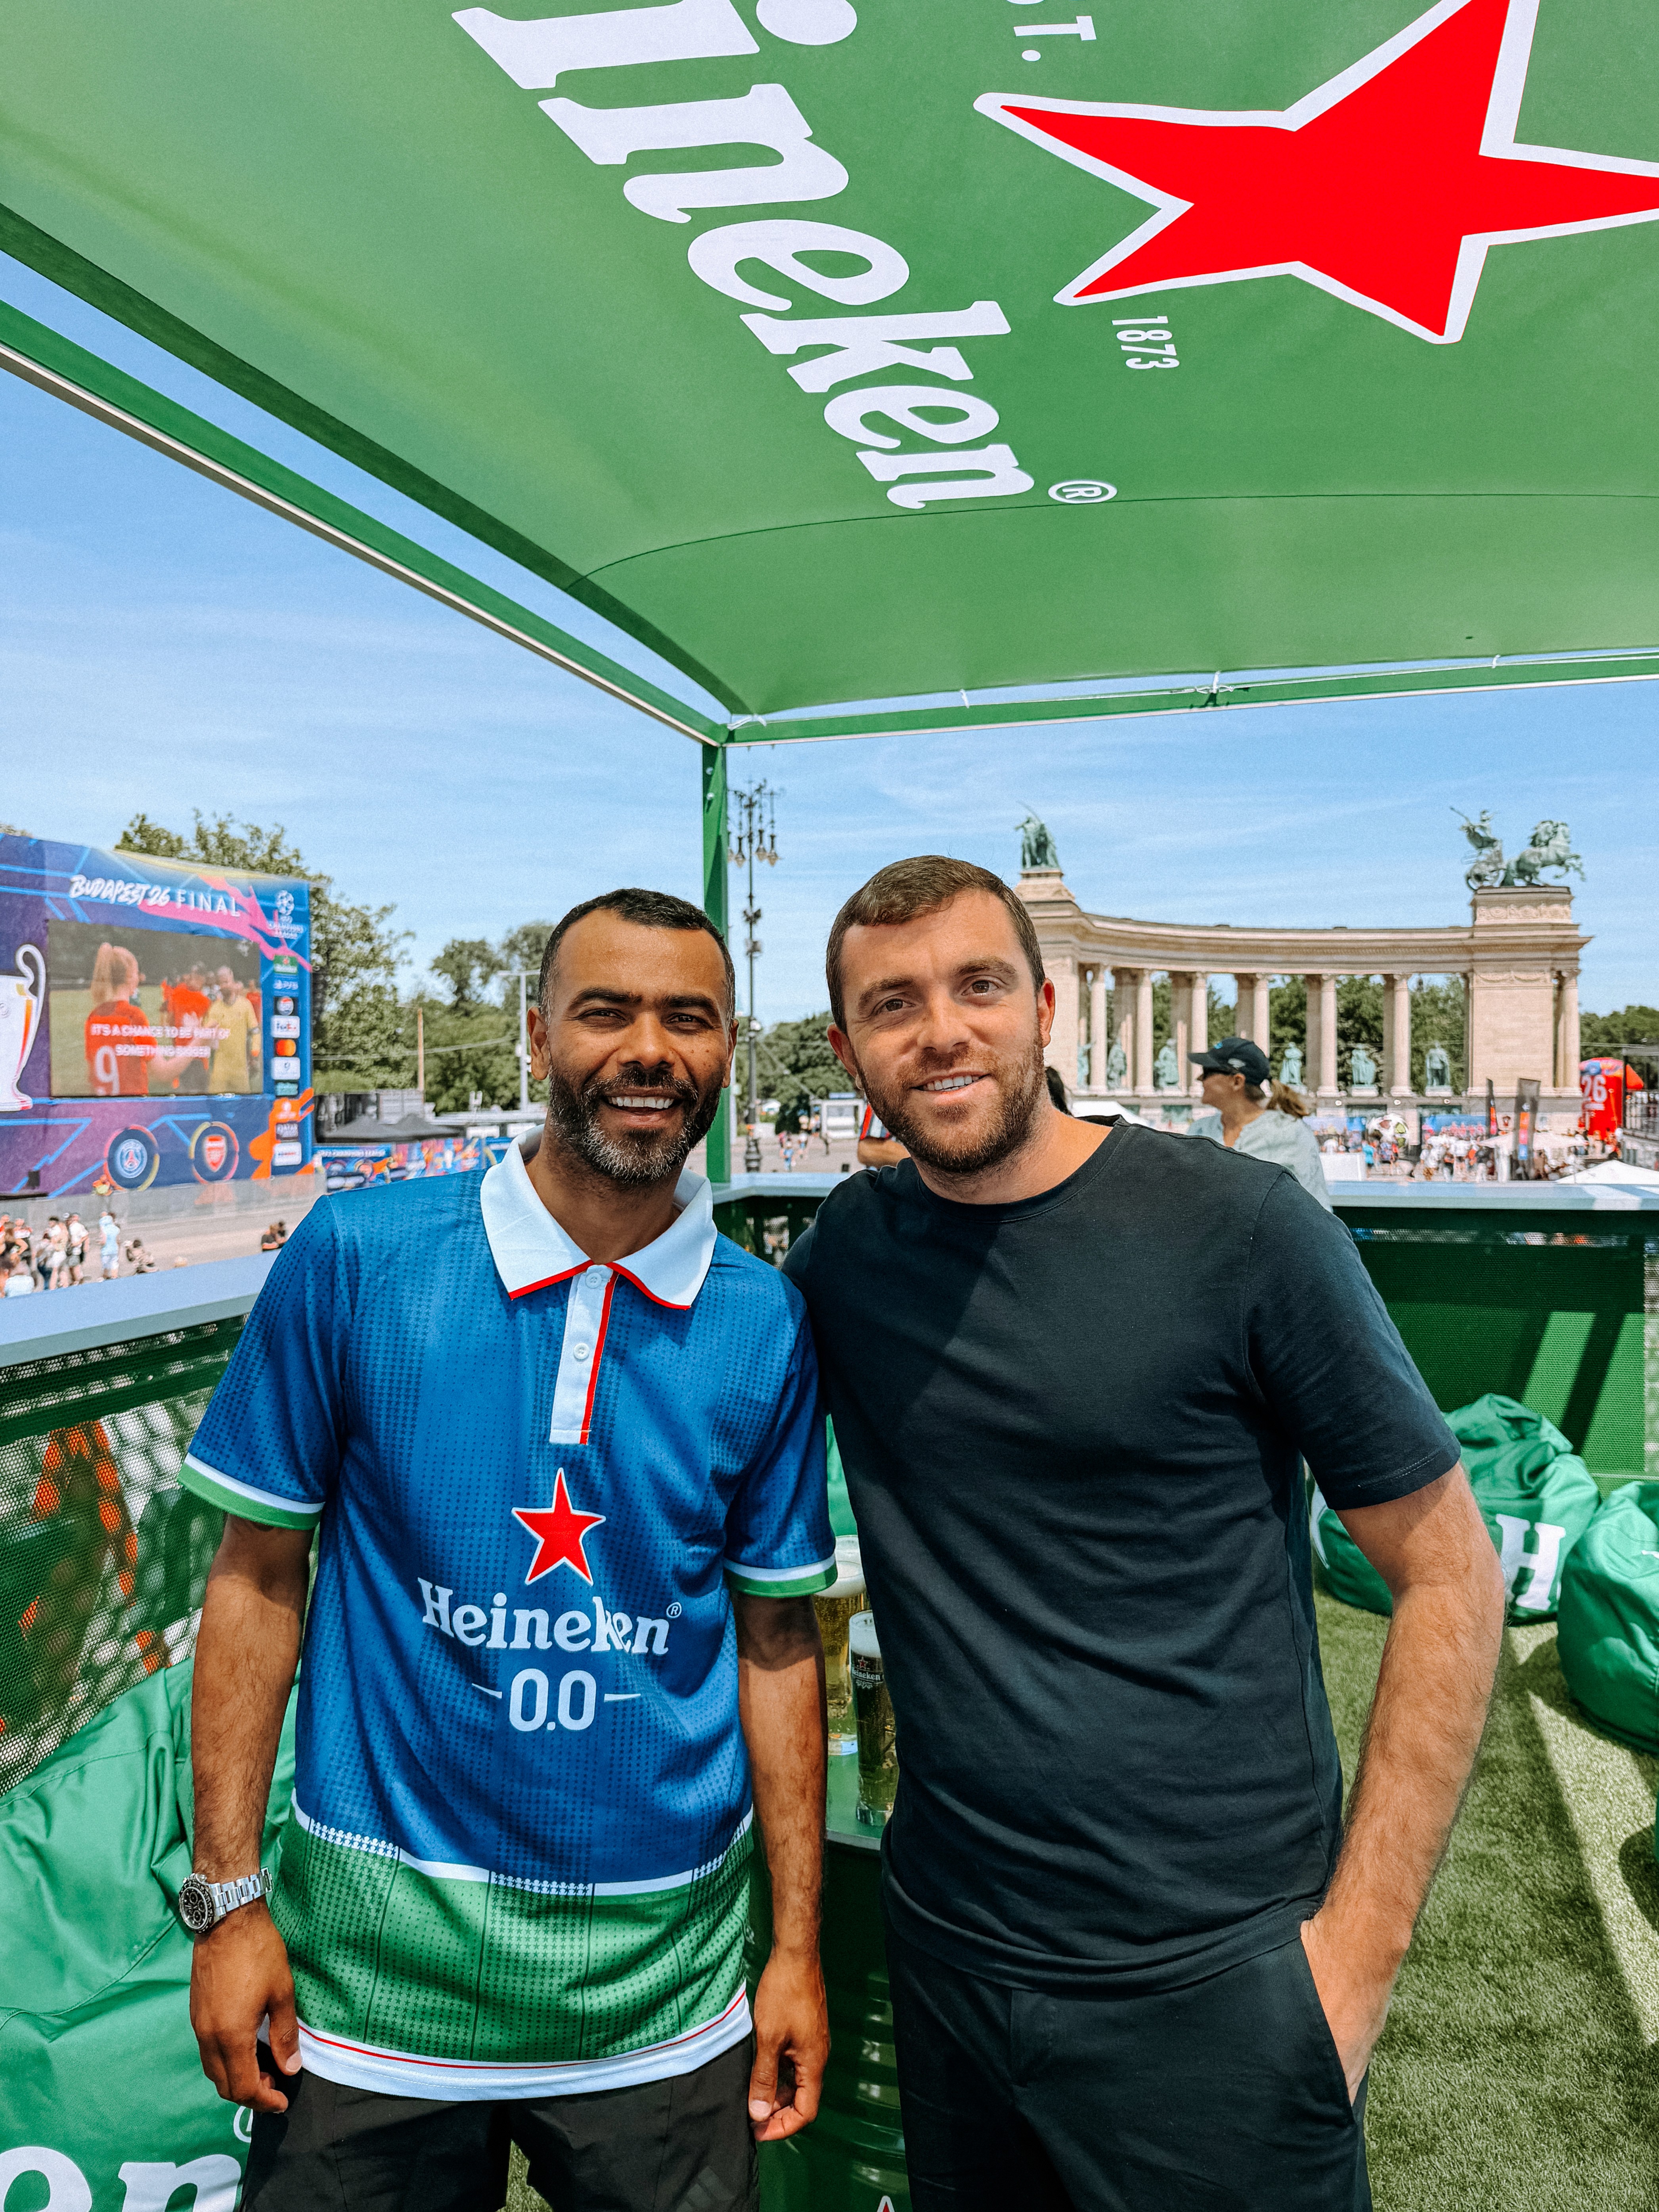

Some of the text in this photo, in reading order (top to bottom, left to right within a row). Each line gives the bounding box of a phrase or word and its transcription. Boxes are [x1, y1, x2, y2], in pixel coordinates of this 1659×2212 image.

[1005, 0, 1096, 61] T.
[1112, 316, 1180, 369] 1873
[69, 874, 151, 905] BUDAPEST
[175, 888, 240, 917] FINAL
[95, 1046, 120, 1096] 9
[509, 1668, 597, 1732] 0.0
